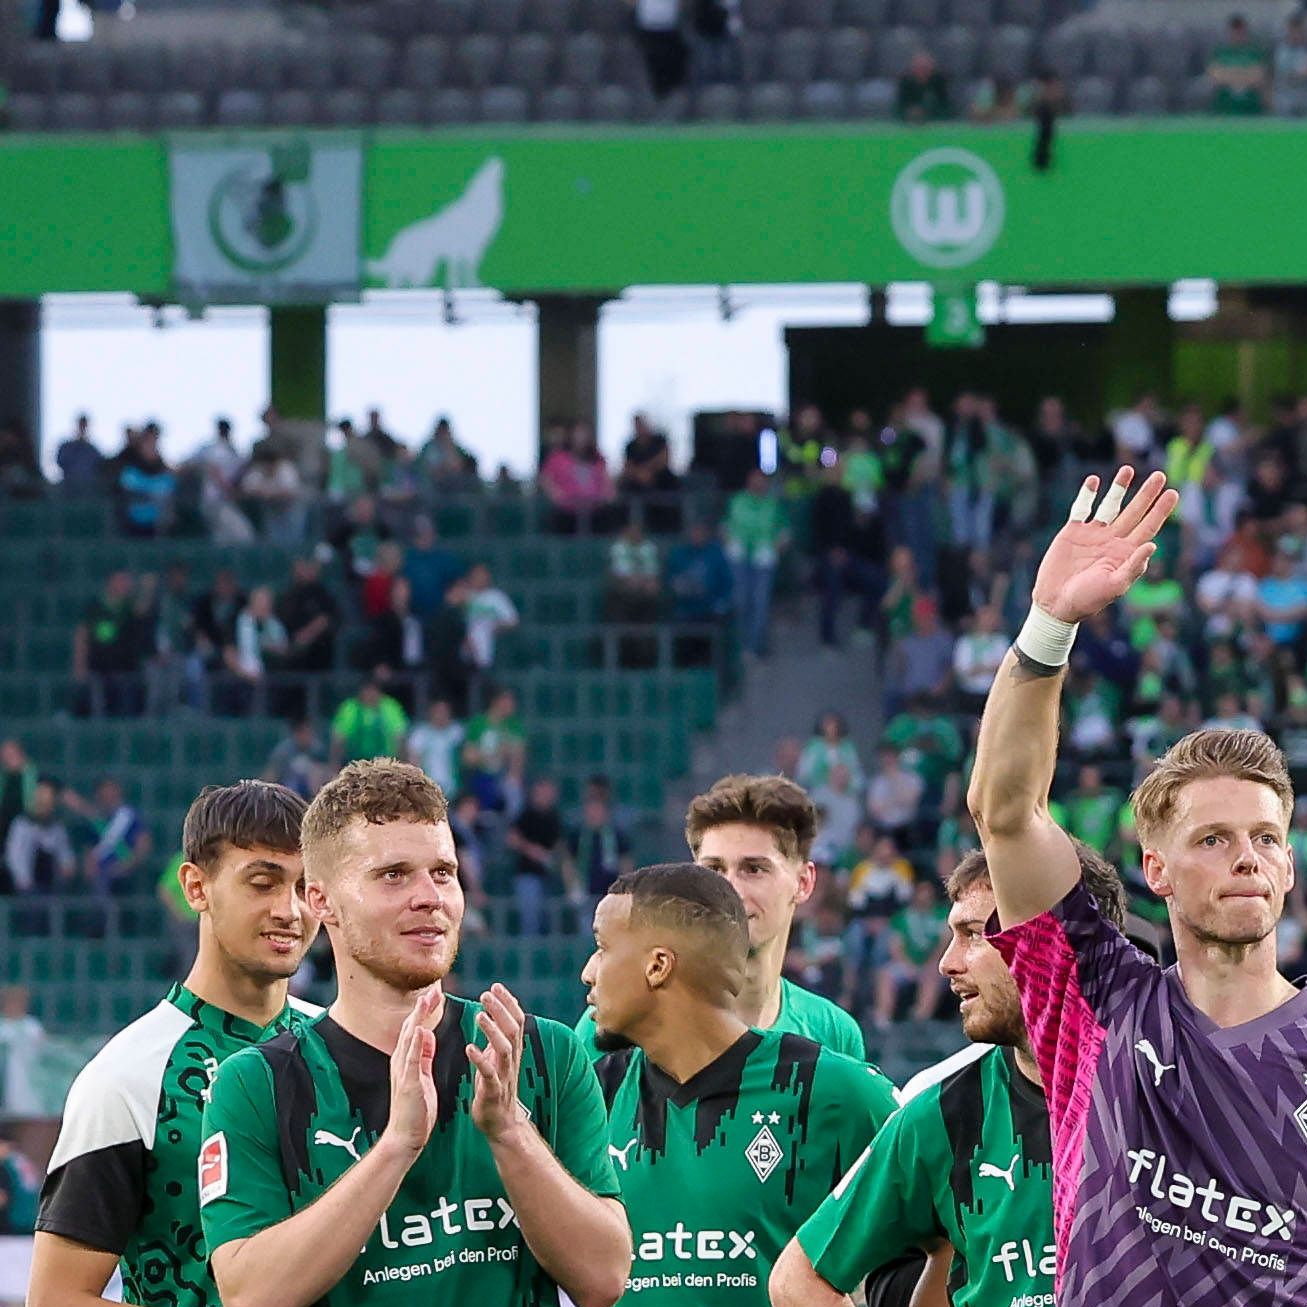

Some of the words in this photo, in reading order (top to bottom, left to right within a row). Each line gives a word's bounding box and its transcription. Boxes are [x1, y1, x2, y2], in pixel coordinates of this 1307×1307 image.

[363, 1262, 432, 1286] Anlegen
[434, 1250, 456, 1273] bei
[459, 1248, 485, 1264] den
[487, 1245, 519, 1263] Profi
[992, 1239, 1056, 1282] fla
[1184, 1225, 1207, 1247] bei
[1241, 1247, 1287, 1272] Profis
[662, 1273, 682, 1287] bei
[685, 1273, 713, 1287] den
[716, 1273, 757, 1287] Profis
